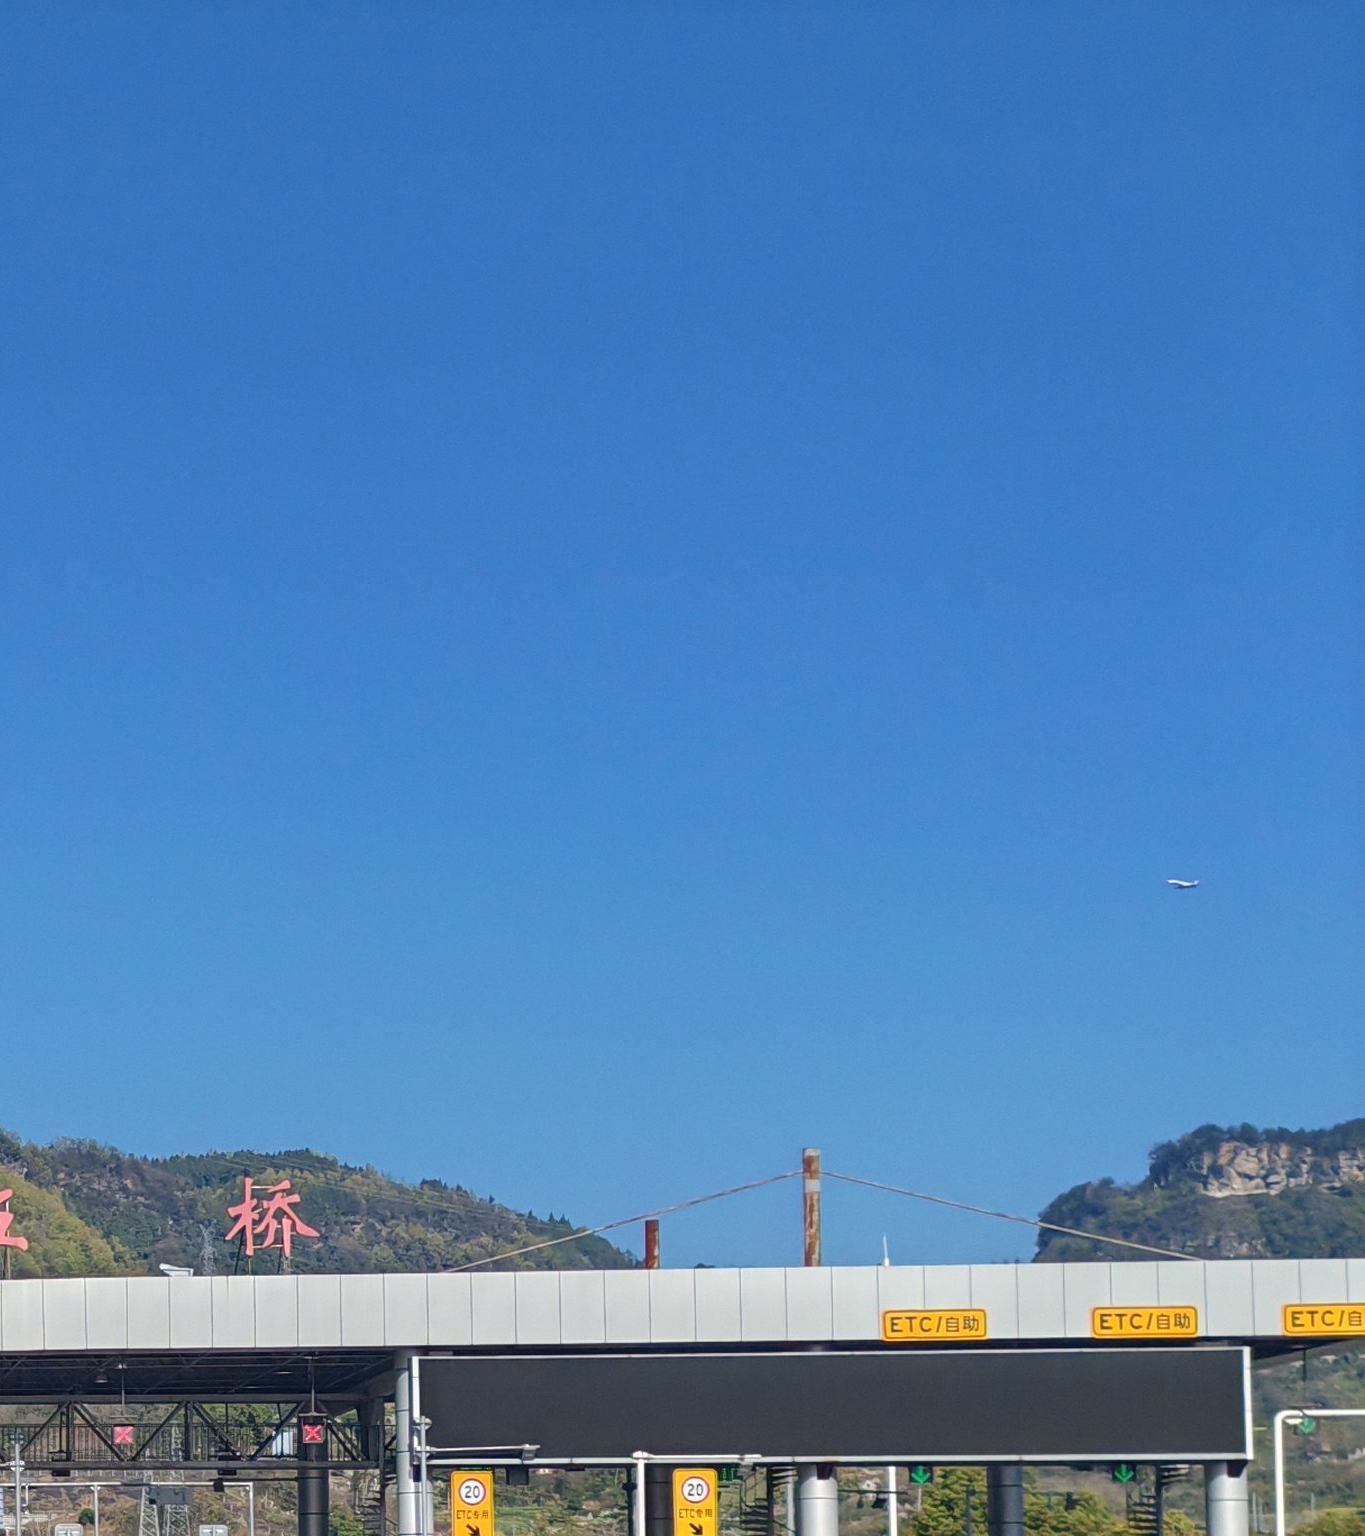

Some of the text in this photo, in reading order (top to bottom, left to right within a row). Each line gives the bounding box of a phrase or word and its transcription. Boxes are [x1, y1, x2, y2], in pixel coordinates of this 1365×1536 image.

[890, 1315, 980, 1334] ETC/自助
[1100, 1313, 1191, 1331] ETC/自助
[464, 1485, 481, 1499] 20
[687, 1483, 704, 1497] 20
[456, 1509, 489, 1520] ETC专用
[678, 1508, 713, 1519] ETC专用
